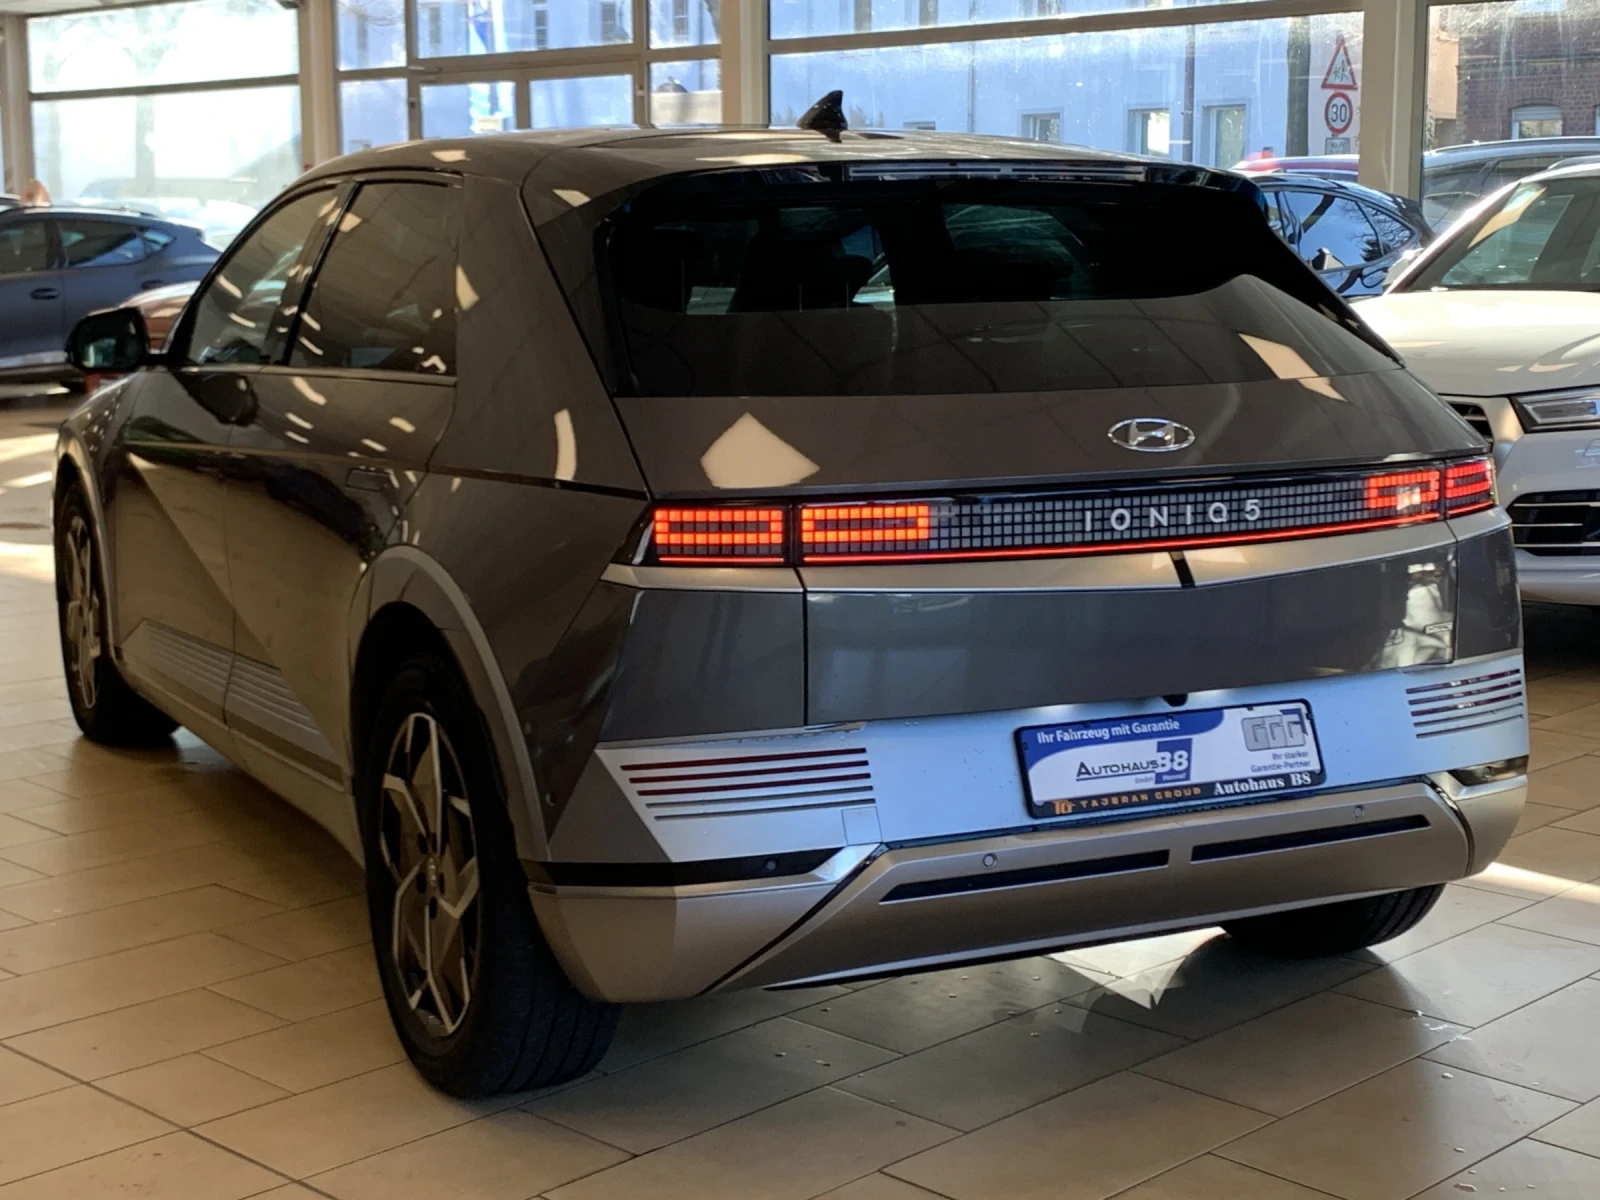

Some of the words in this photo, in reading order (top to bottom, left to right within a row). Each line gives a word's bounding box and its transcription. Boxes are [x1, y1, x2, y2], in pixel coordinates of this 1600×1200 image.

[1331, 104, 1348, 122] 30
[1085, 502, 1227, 532] IONIQ
[1245, 500, 1260, 520] 5
[1037, 732, 1053, 744] Ihr
[1056, 726, 1110, 740] Fahrzeug
[1112, 725, 1131, 736] mit
[1132, 718, 1181, 734] Garantie
[1272, 752, 1282, 760] Ihr
[1251, 761, 1311, 772] Garantie-Partner
[1213, 778, 1285, 796] Autohaus
